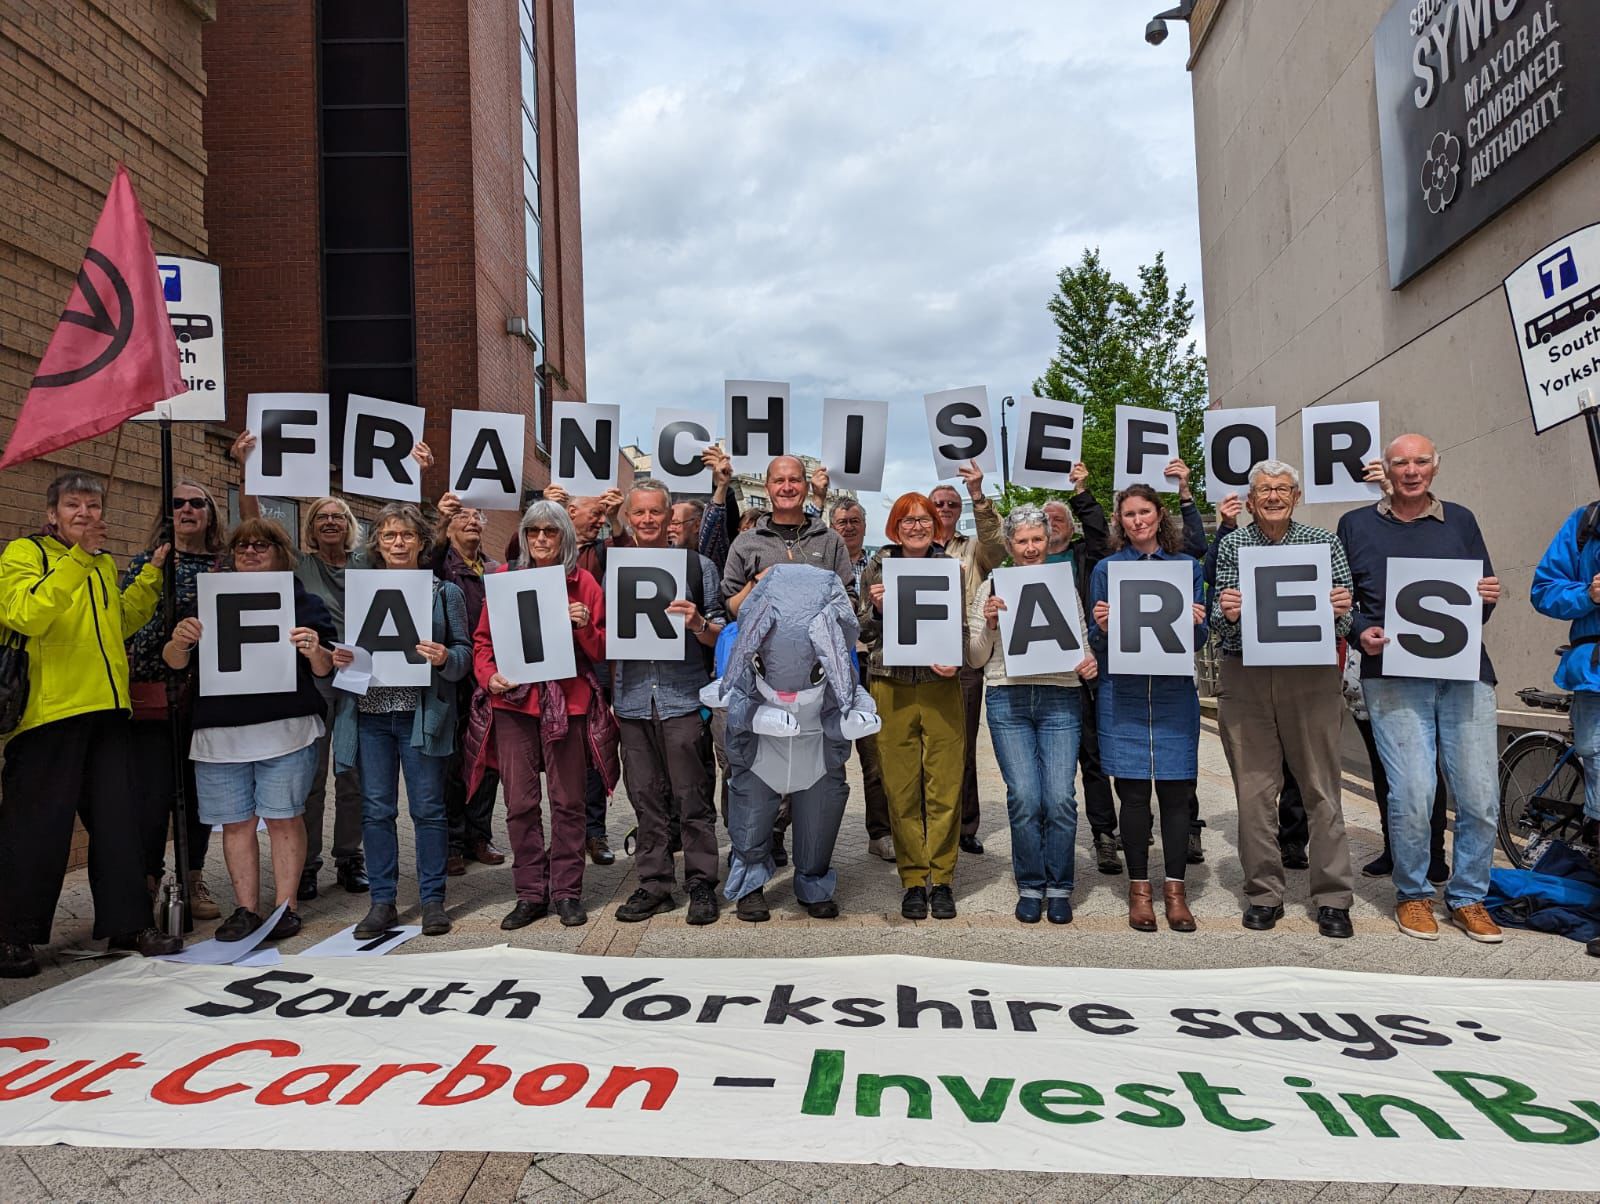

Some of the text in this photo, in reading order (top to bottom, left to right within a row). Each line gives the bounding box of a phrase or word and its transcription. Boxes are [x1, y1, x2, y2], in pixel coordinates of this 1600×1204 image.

[1464, 0, 1561, 112] MAYORAL
[1466, 40, 1562, 148] COMBINED
[1470, 81, 1562, 187] AUTHORITY
[184, 970, 1502, 1060] South Yorkshire says:
[150, 1039, 680, 1111] Carbon
[802, 1048, 1276, 1132] Invest
[1283, 1075, 1466, 1140] in
